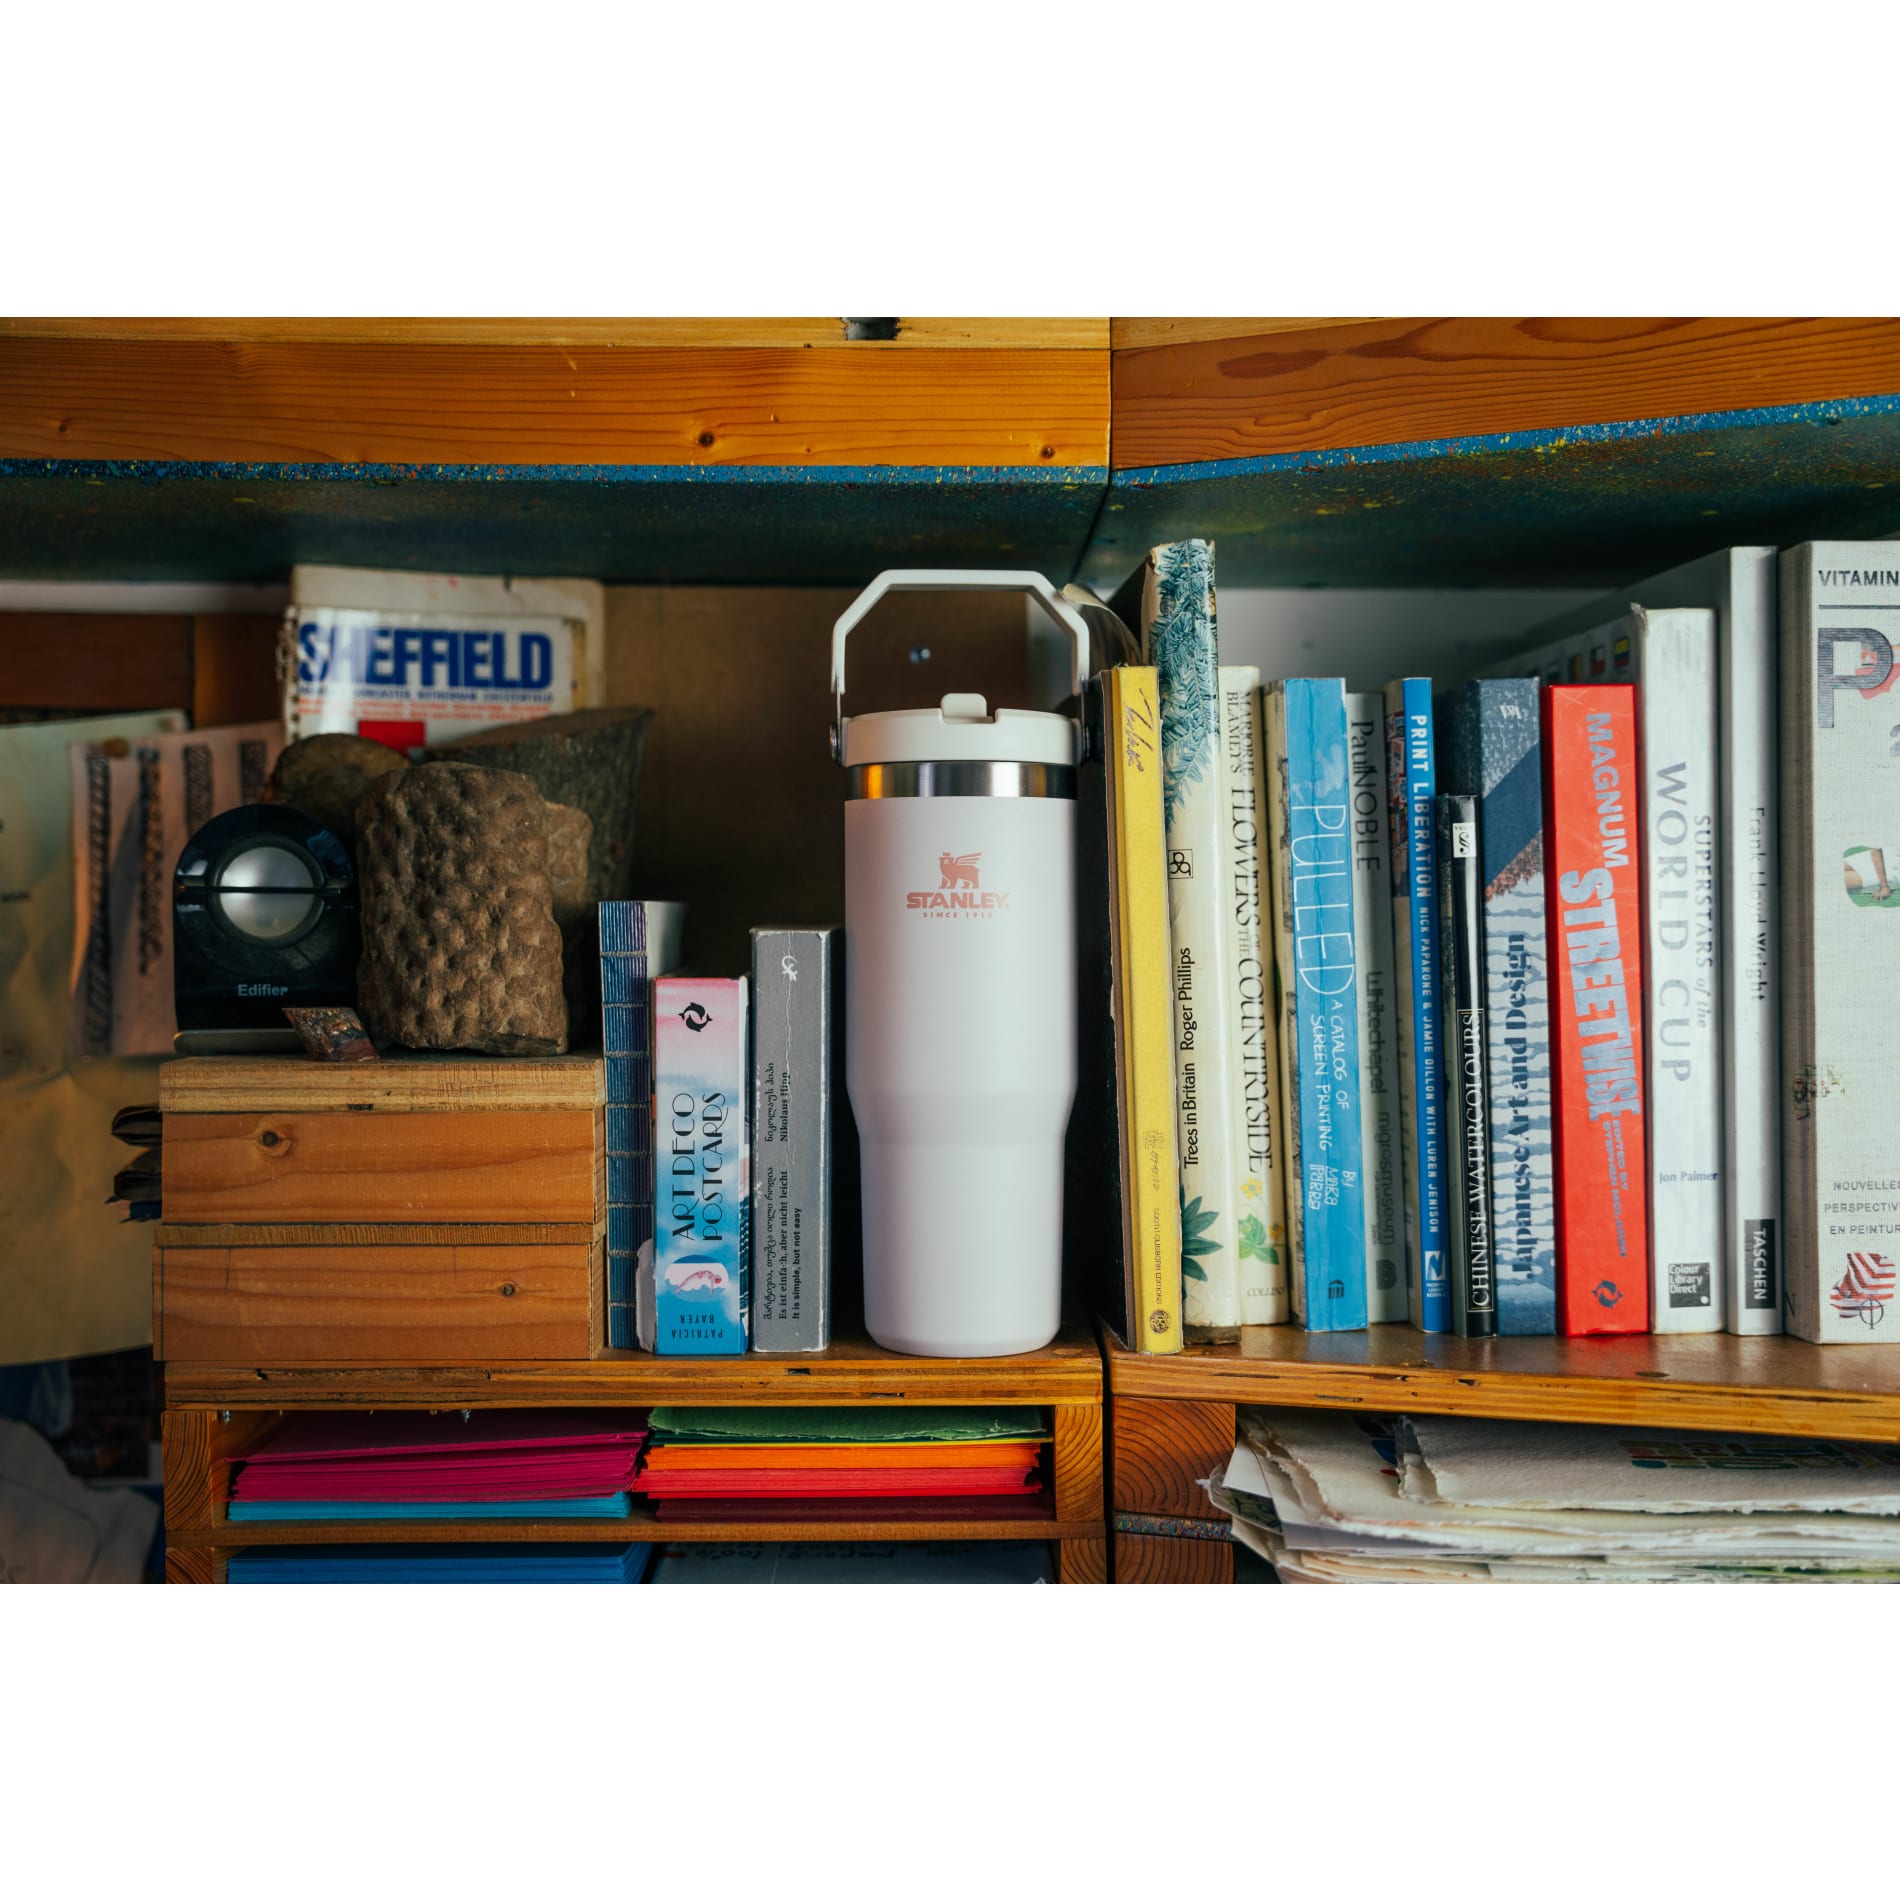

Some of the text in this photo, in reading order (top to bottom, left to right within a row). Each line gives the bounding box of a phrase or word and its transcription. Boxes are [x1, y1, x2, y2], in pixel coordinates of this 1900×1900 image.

[1818, 569, 1899, 587] VITAMIN
[1817, 627, 1894, 729] P
[1226, 691, 1242, 774] BLAMEY'S
[1410, 714, 1432, 898] PRINT LIBERATION
[1585, 712, 1630, 868] MAGNUM
[1231, 787, 1261, 927] FLOWERS
[906, 892, 1009, 909] STANLEY
[923, 911, 957, 919] SINCE
[1291, 805, 1355, 995] PULLED
[1656, 761, 1691, 1082] WORLD CUP
[1694, 815, 1713, 1029] SUPERSTARS of the
[1745, 807, 1768, 1000] Frank Lloyd Wright
[1238, 929, 1250, 957] THE
[238, 984, 288, 997] Edifier
[1177, 947, 1198, 1050] Roger Phillips
[1559, 866, 1641, 1122] STREETWISE
[1238, 957, 1273, 1174] COUNTRYSIDE
[1330, 999, 1350, 1111] A CATALOG OF
[1366, 970, 1388, 1094] Whitechapel
[1419, 906, 1440, 1233] NICK PAPARONE & JAMIE DILLON WITH LUREN JENISON
[779, 1099, 789, 1142] Nikolaus
[1181, 1063, 1198, 1169] Trees in Britain
[1310, 1014, 1333, 1151] SCREEN PRINTING
[1502, 934, 1538, 1279] Japanese Art and Design
[672, 1092, 700, 1242] ART DECO
[702, 1092, 729, 1242] POSTCARDS
[779, 1170, 788, 1200] leicht
[1463, 1013, 1490, 1307] CHINESE WATERCOLOURS
[1602, 1121, 1618, 1187] STEPHEN
[1612, 1119, 1629, 1191] EDITED BY
[1659, 1170, 1718, 1184] Jon Palmer
[779, 1200, 788, 1227] nicht
[779, 1230, 788, 1252] aber
[1824, 1202, 1900, 1213] PERSPECTIV
[1830, 1225, 1845, 1235] EN
[779, 1294, 787, 1306] ist
[792, 1207, 802, 1320] It is simple, but not easy
[1669, 1264, 1700, 1275] Colour
[1669, 1274, 1703, 1286] Library
[1670, 1284, 1697, 1294] Direct
[1752, 1227, 1769, 1300] TASCHEN
[671, 1327, 724, 1339] PATRICIA
[679, 1313, 715, 1325] BAYER
[779, 1308, 788, 1320] Es
